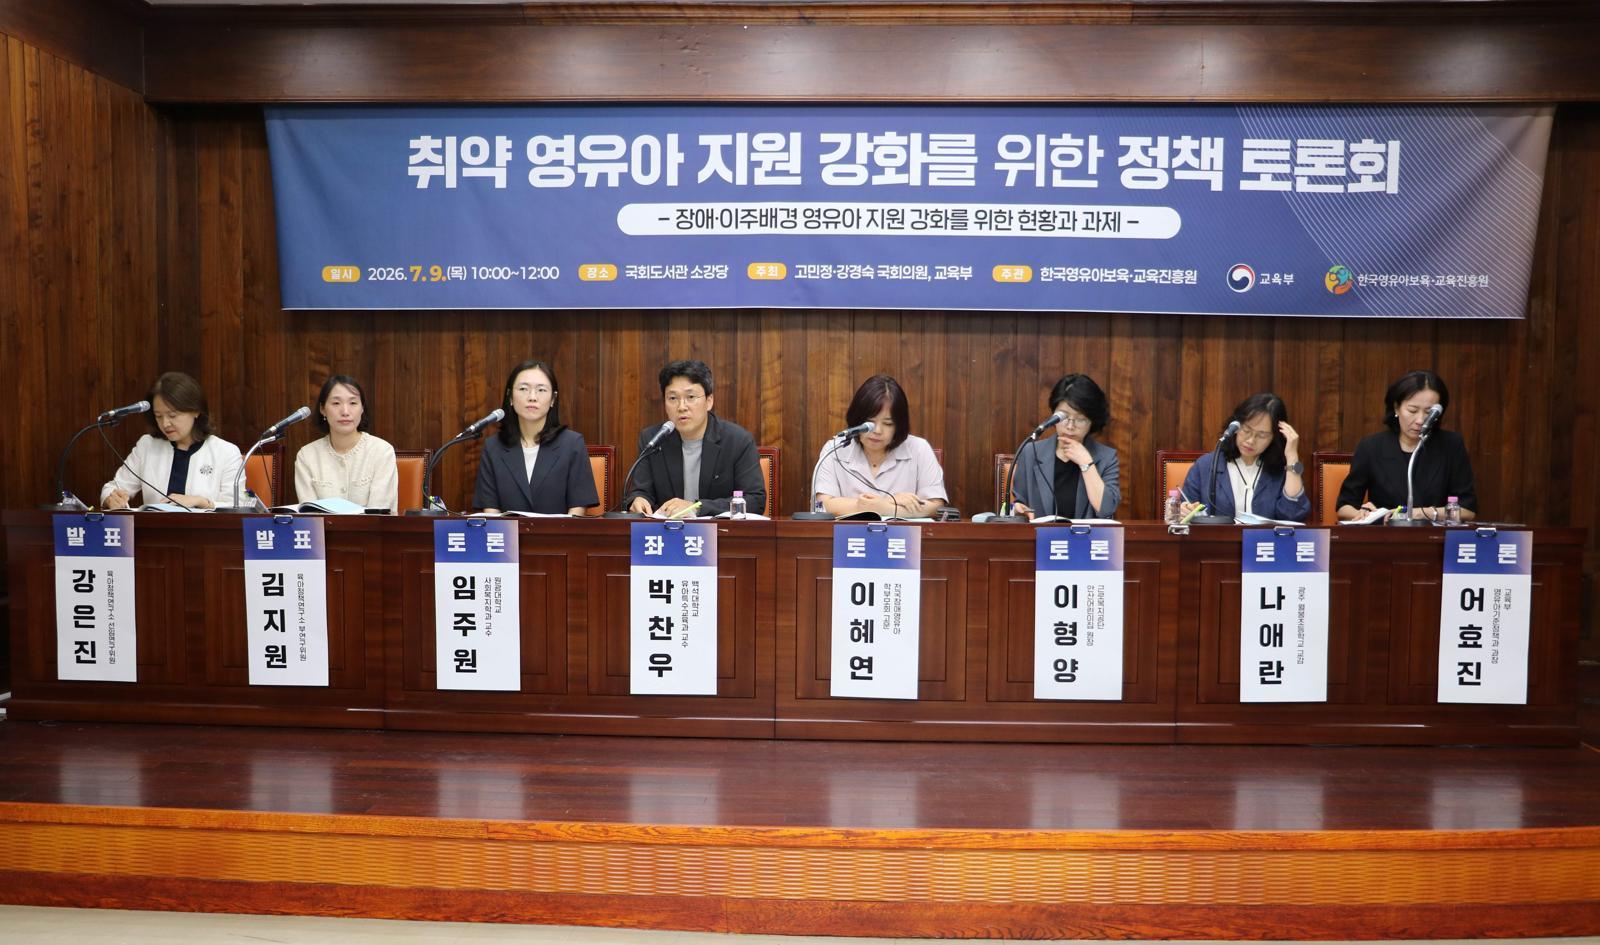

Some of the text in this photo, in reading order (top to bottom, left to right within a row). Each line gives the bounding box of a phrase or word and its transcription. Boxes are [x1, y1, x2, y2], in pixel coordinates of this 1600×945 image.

[408, 132, 1401, 195] 취약 영유아 지원 강화를 위한 정책 토론회
[676, 208, 797, 229] 장애·이주배경
[803, 208, 861, 229] 영유아
[867, 209, 904, 229] 지원
[911, 209, 968, 230] 강화를
[974, 210, 1013, 230] 위한
[1018, 210, 1077, 231] 현황과
[1082, 211, 1120, 232] 과제
[329, 267, 353, 281] 일시
[368, 267, 408, 281] 2026.
[471, 265, 560, 281] 10:00~12:00
[585, 266, 611, 281] 장소
[626, 265, 728, 279] 국회도서관 소강당
[755, 264, 781, 280] 주최
[795, 265, 972, 281] 고민정·강경숙 국회의원, 교육부
[1000, 266, 1026, 282] 주관
[1041, 267, 1196, 284] 한국영유아보육·교육진흥원
[1259, 273, 1295, 286] 교육부
[1357, 273, 1490, 288] 한국영유아보육·교육진흥원
[72, 569, 97, 664] 강은진
[107, 571, 115, 620] 육아정책연구소
[297, 574, 305, 623] 육아정책연구소
[484, 577, 492, 637] 사회복지학과 교수
[681, 580, 689, 648] 유아특수교육과 교수
[883, 584, 891, 612] 학부모회
[262, 573, 287, 669] 김지원
[453, 576, 477, 673] 임주원
[649, 579, 674, 678] 박찬우
[850, 582, 874, 681] 이혜연
[1053, 584, 1078, 683] 이형양
[1259, 586, 1285, 685] 나애란
[1457, 588, 1484, 686] 어효진
